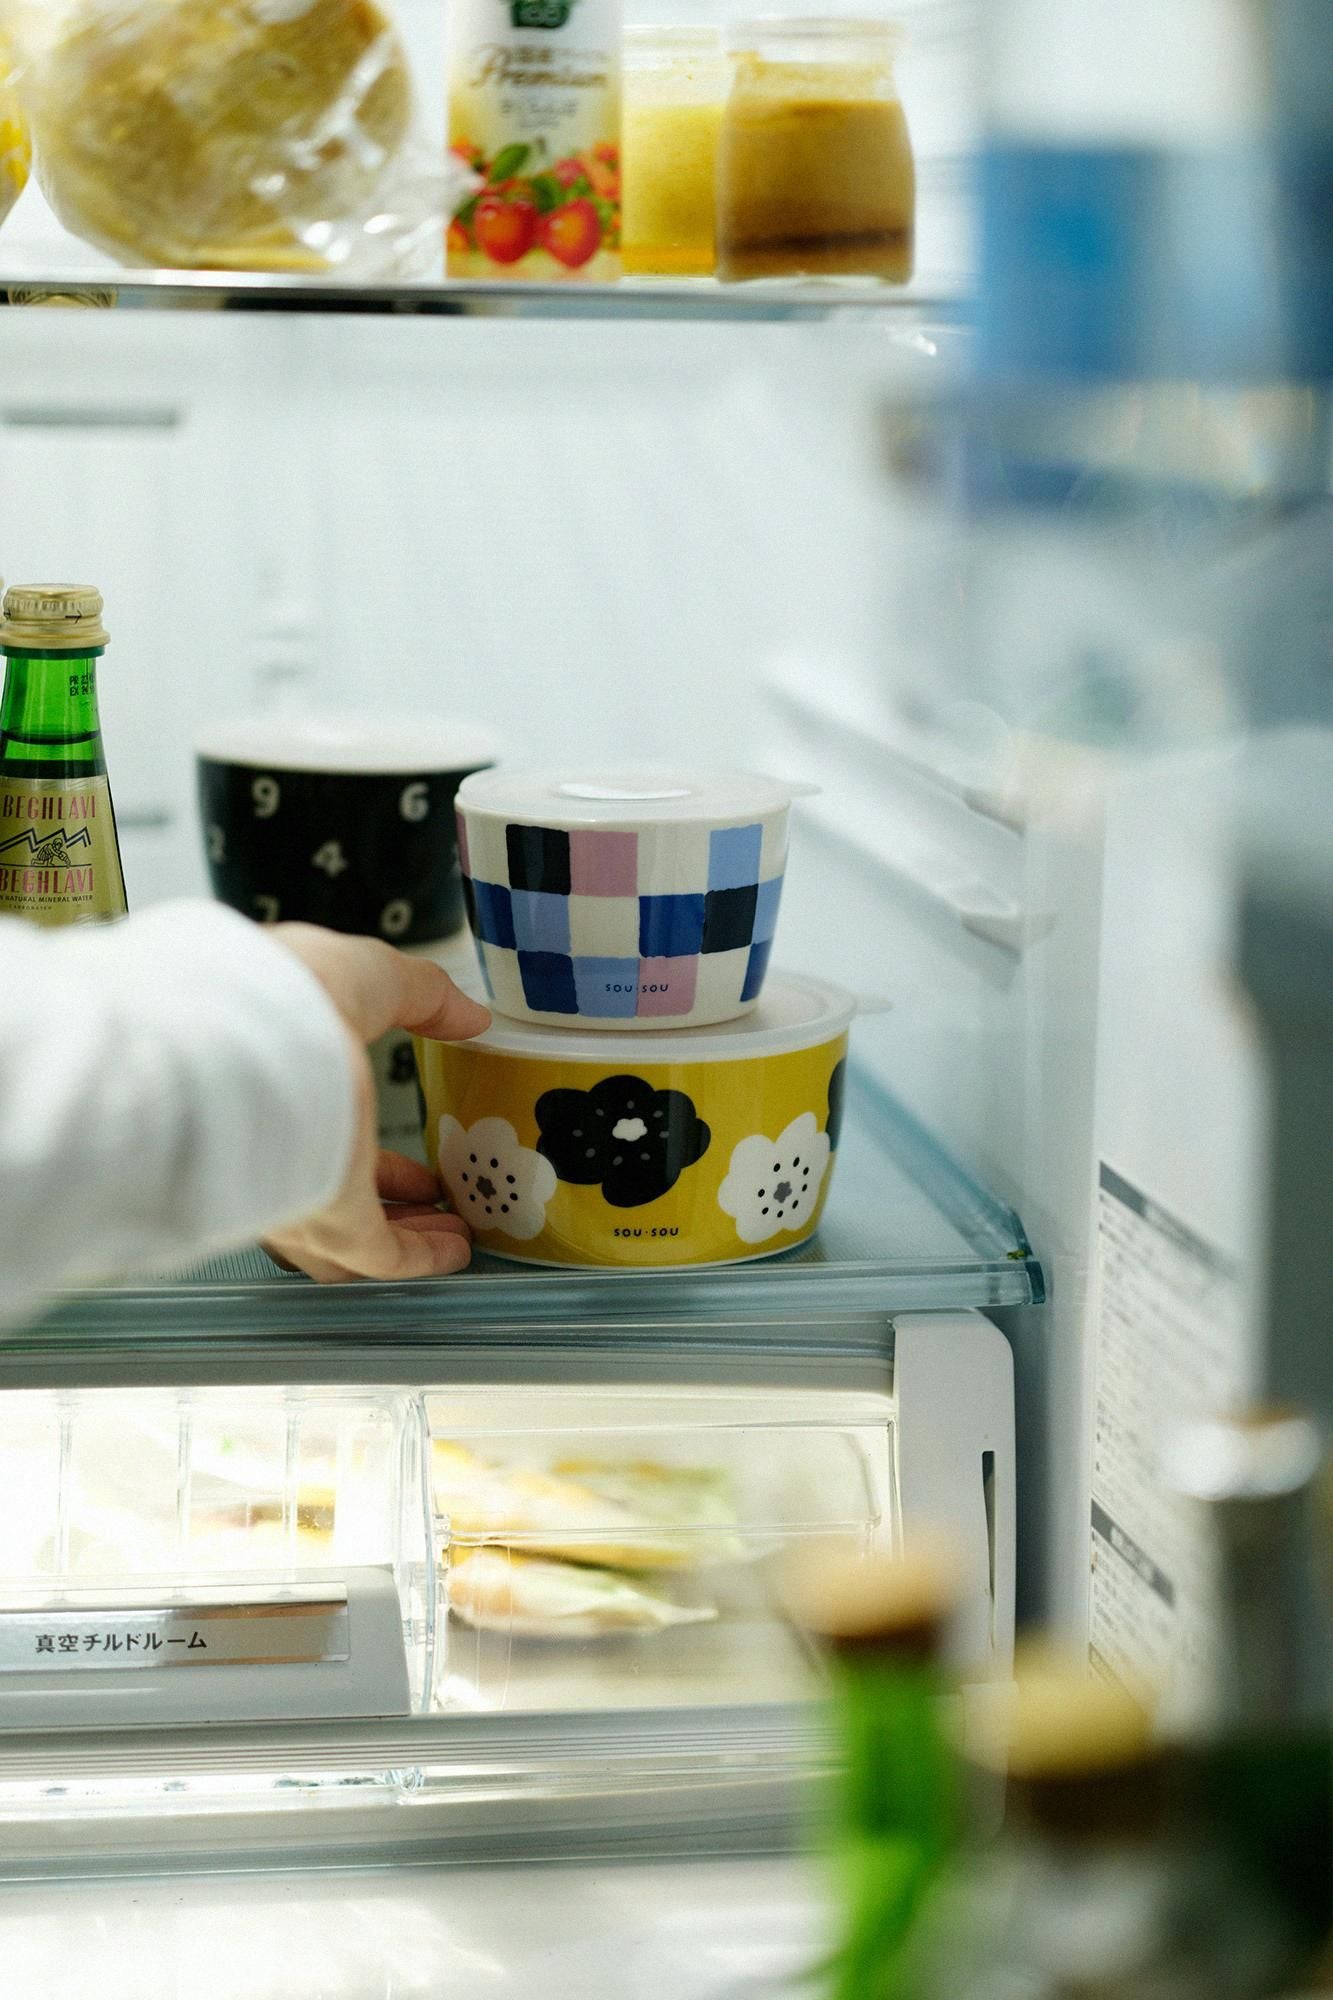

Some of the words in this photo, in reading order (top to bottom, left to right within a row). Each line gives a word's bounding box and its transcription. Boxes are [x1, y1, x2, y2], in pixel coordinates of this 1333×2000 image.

[252, 777, 281, 819] 9
[400, 781, 429, 822] 6
[311, 839, 347, 879] 4
[35, 1631, 207, 1653] 真空チルドルーム
